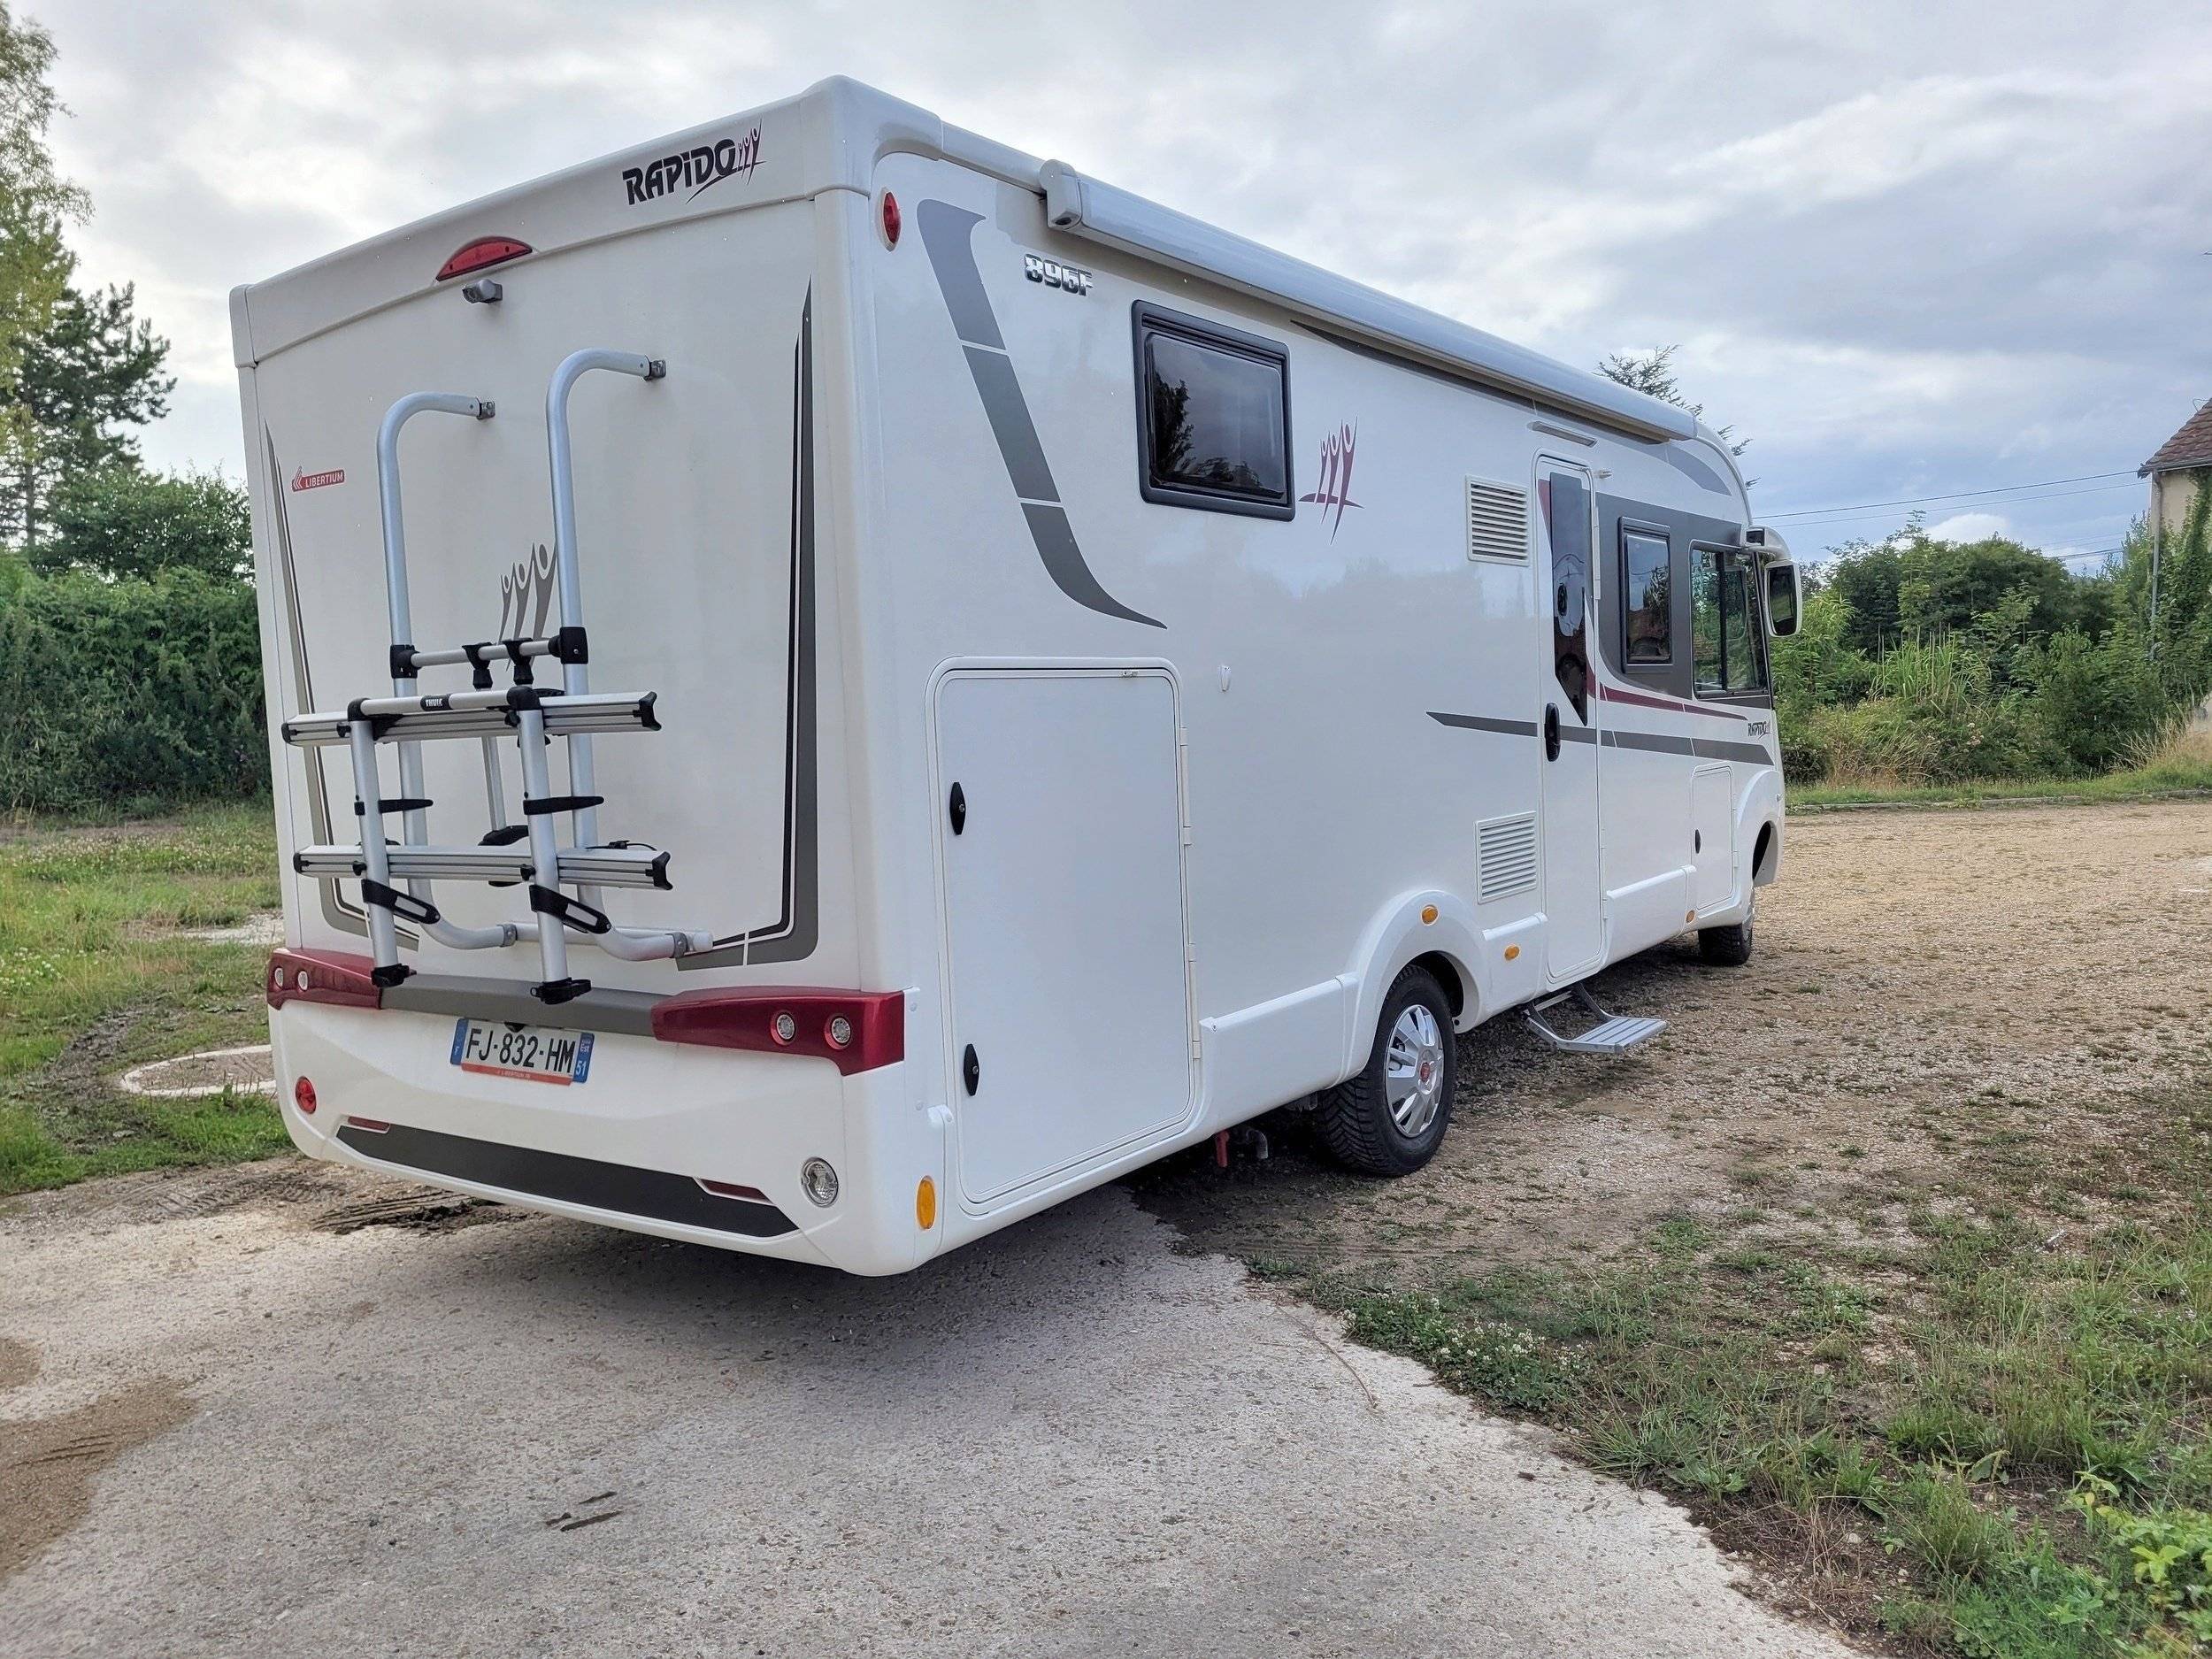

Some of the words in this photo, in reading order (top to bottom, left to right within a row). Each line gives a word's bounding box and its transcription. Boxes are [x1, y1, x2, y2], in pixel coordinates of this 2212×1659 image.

[622, 139, 736, 205] RAPIDO
[1025, 253, 1094, 296] 896F
[305, 472, 343, 488] LIBERTIUM
[425, 698, 443, 707] THULE
[576, 1060, 587, 1076] 51
